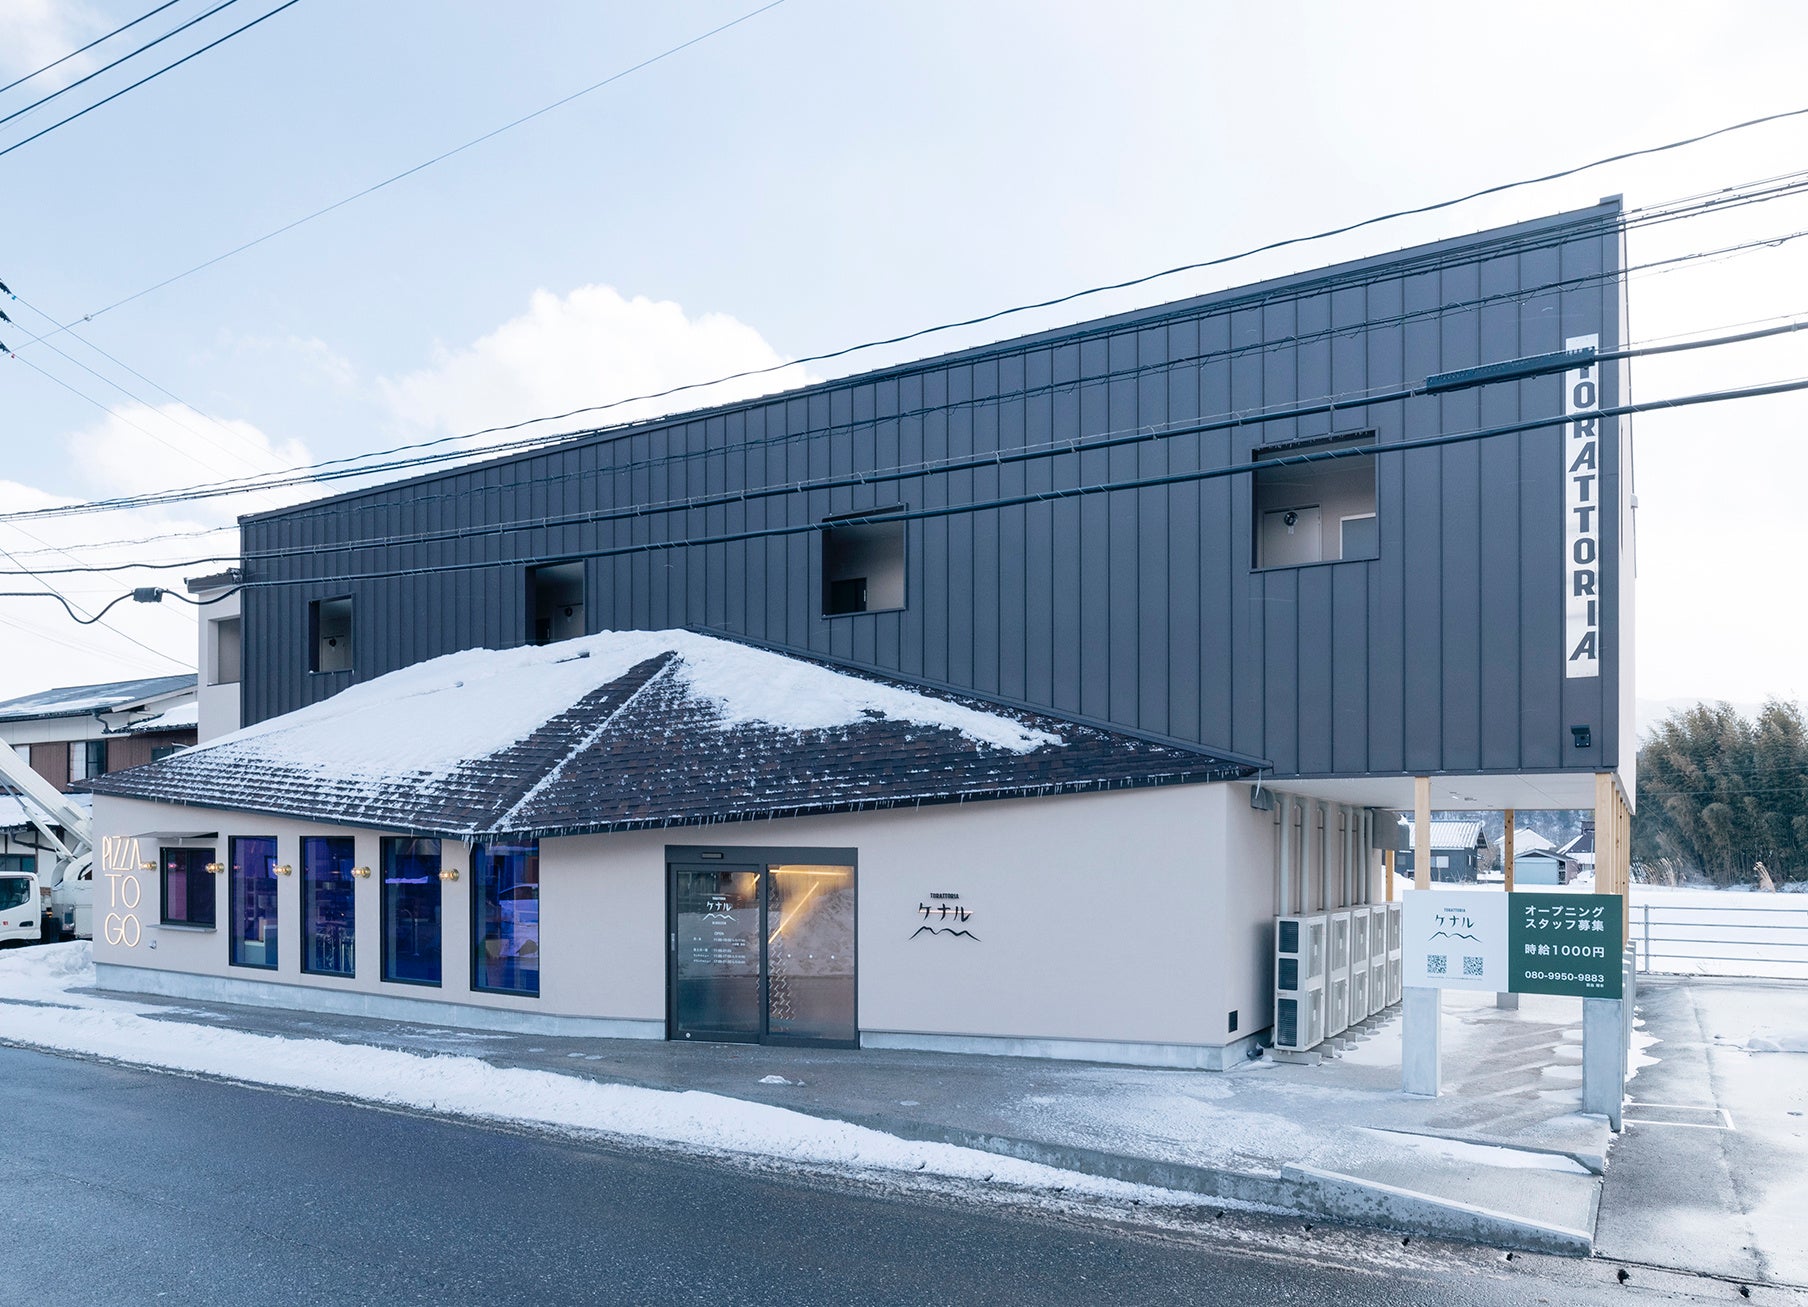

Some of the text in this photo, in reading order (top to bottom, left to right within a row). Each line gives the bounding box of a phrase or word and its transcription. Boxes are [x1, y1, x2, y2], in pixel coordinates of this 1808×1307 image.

[103, 836, 141, 871] PIZZA
[104, 874, 140, 909] TO
[707, 901, 732, 911] ケナル
[919, 902, 972, 922] ケナル
[1525, 905, 1605, 918] オープニング
[1435, 914, 1475, 928] ケナル
[1525, 919, 1605, 932] スタッフ募集
[104, 912, 141, 947] GO
[1525, 943, 1605, 958] 時給1000円
[1525, 971, 1605, 983] 080-9950-9883
